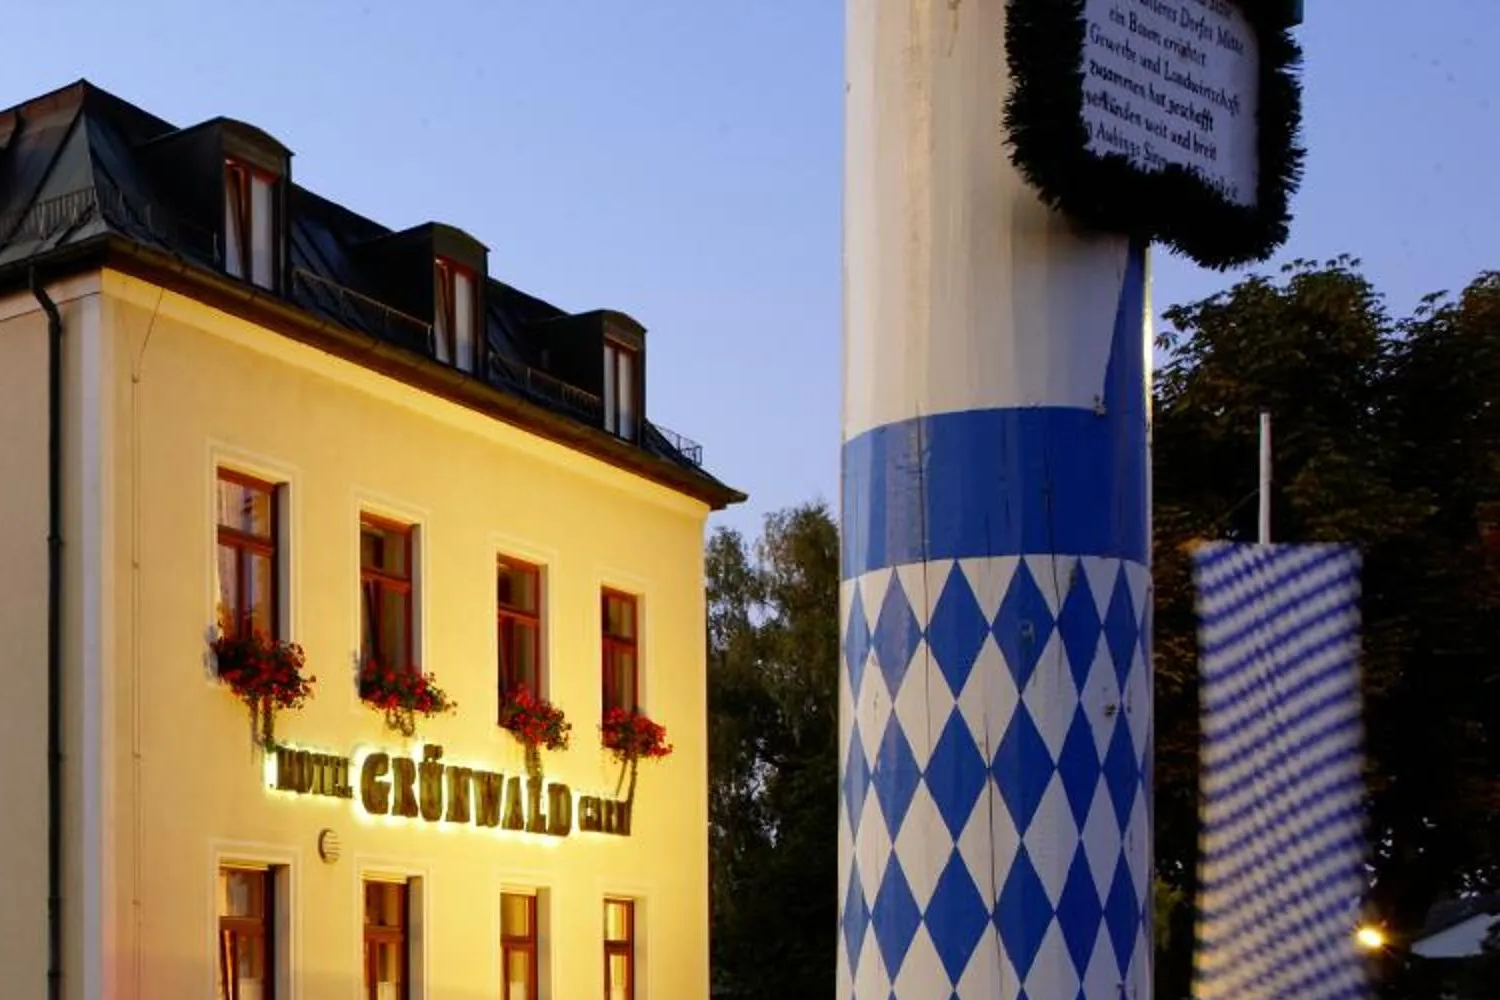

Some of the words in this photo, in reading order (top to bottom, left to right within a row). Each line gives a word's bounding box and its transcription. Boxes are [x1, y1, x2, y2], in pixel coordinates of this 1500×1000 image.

[1109, 4, 1125, 27] ein
[1089, 22, 1137, 61] Gewerbe
[1140, 55, 1161, 75] und
[1164, 60, 1240, 117] Landwirtschaft
[1090, 59, 1146, 99] zusammen
[1149, 82, 1166, 107] hat
[1165, 99, 1214, 133] geschafft
[1086, 90, 1141, 127] verkünden
[1145, 117, 1168, 139] weit
[1169, 129, 1190, 151] und
[1192, 132, 1217, 160] breit
[276, 745, 353, 799] HOTEL
[360, 743, 573, 837] GRÜNWALD
